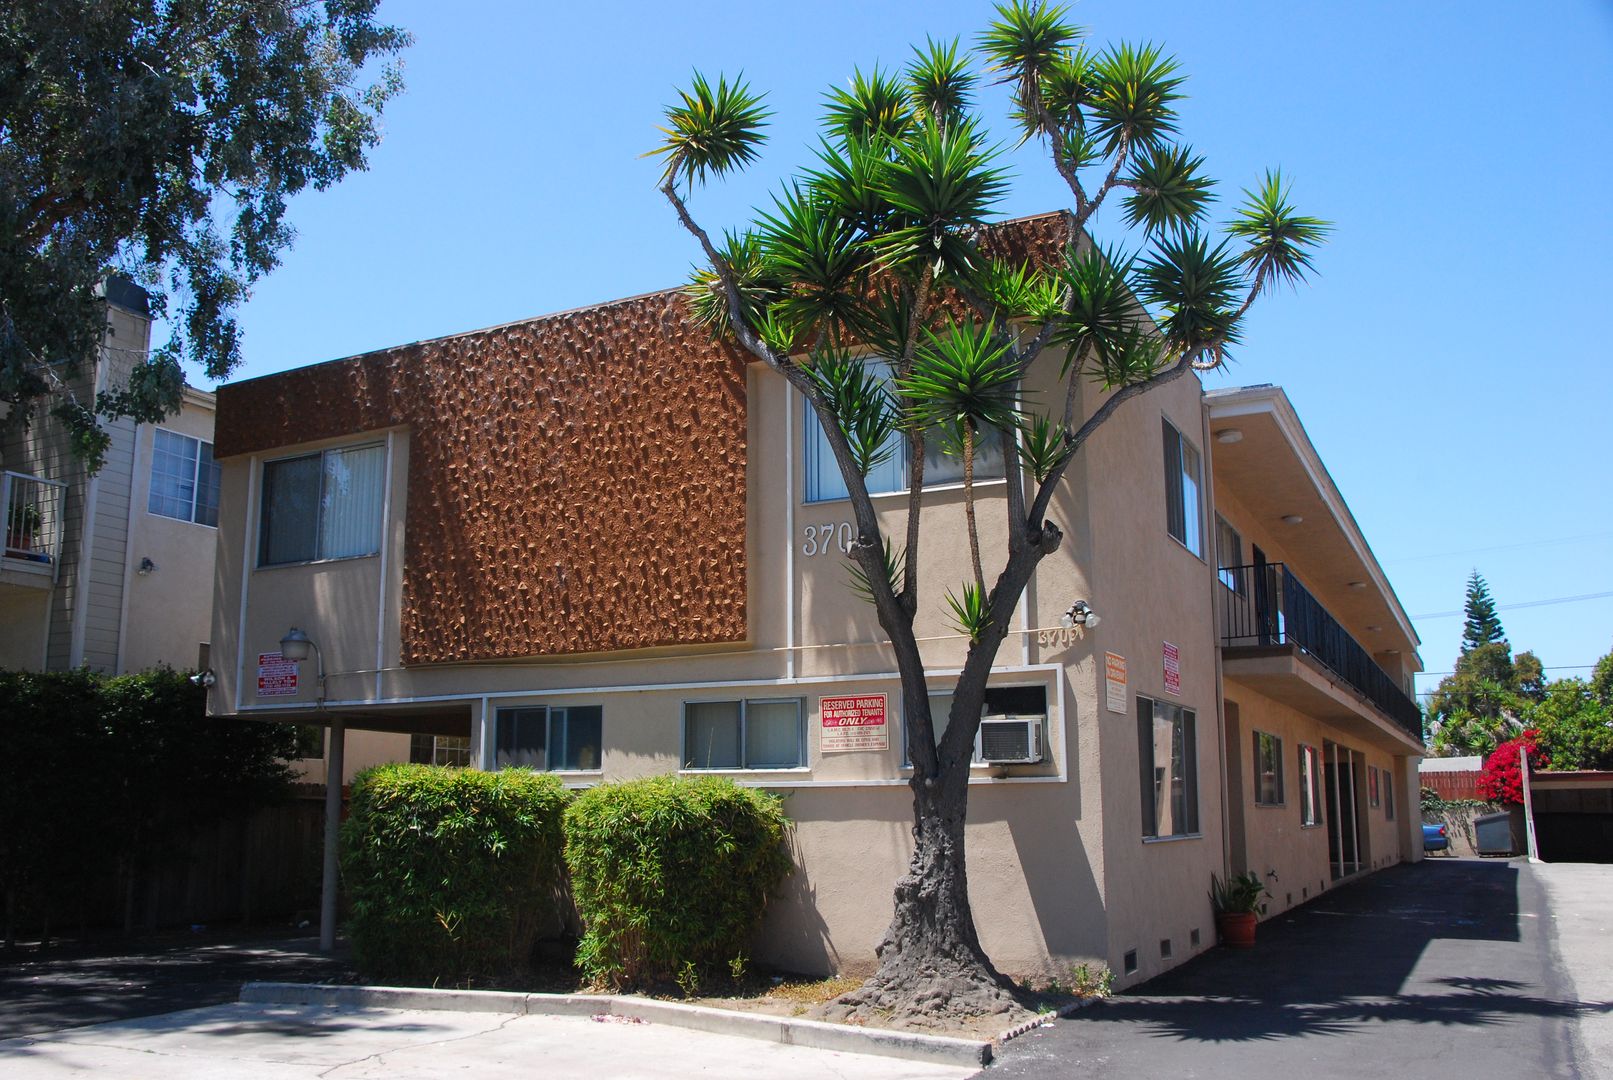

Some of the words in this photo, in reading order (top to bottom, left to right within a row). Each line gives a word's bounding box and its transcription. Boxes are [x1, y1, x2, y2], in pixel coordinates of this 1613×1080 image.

[803, 522, 859, 556] 370
[824, 701, 854, 710] RESERVED
[857, 699, 883, 708] PARKING
[839, 717, 867, 725] ONLY
